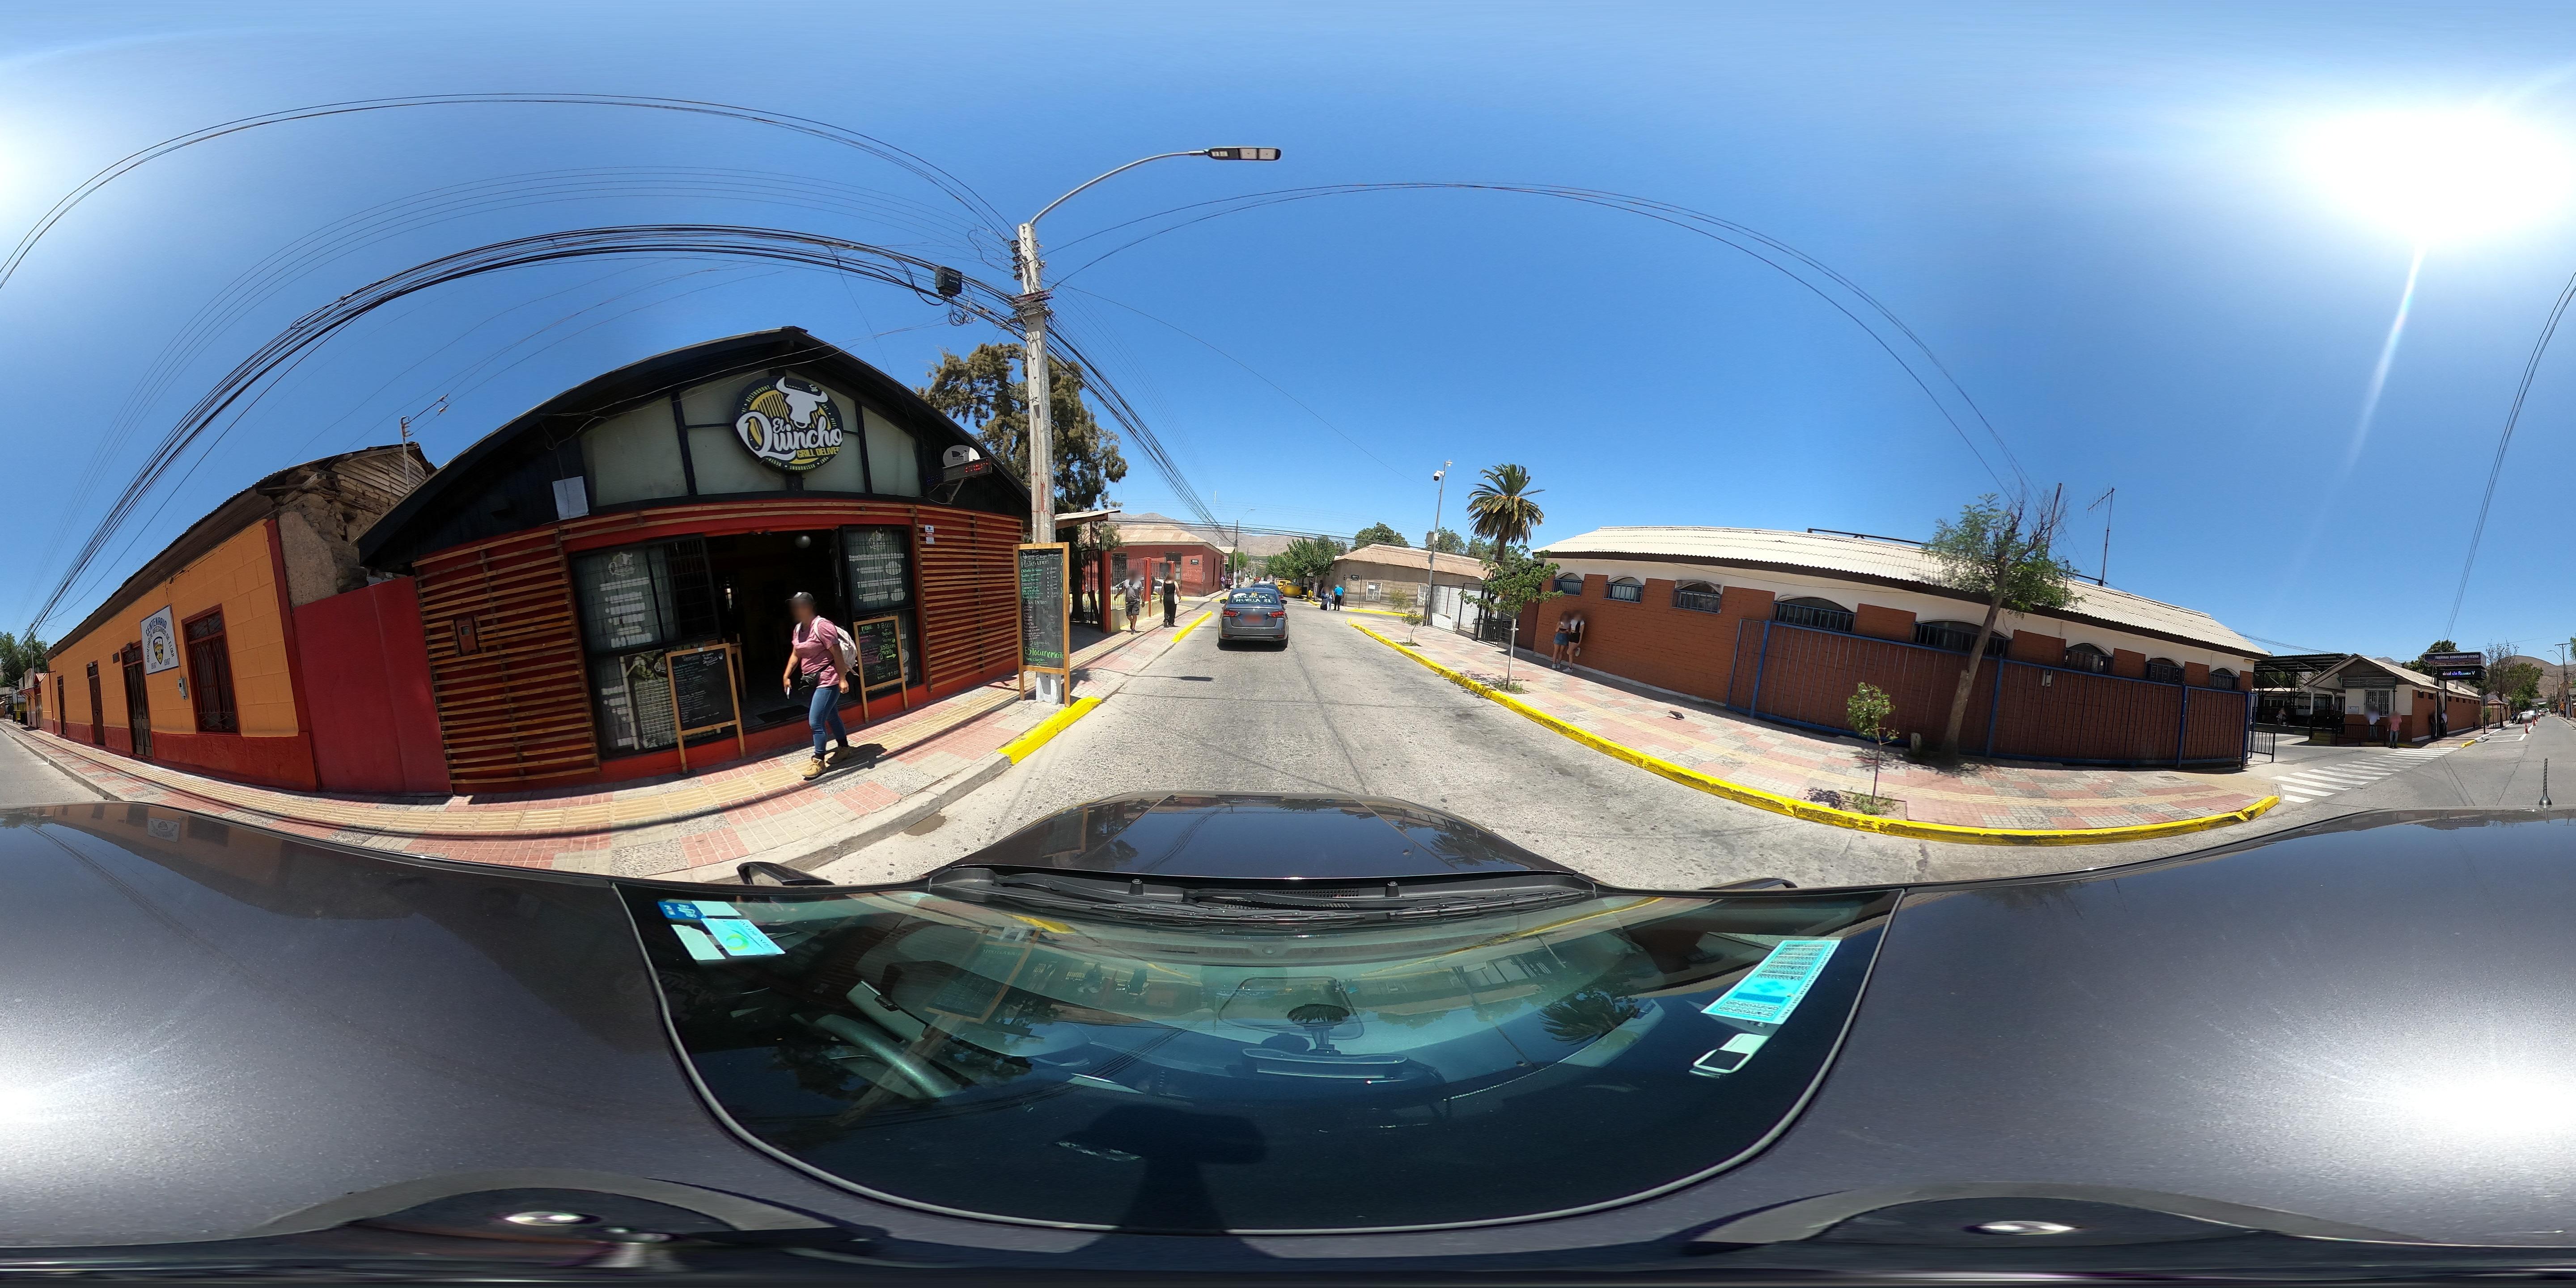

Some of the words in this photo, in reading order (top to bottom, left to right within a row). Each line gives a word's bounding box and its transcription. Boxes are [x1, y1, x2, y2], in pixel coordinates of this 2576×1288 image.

[773, 418, 786, 432] El
[736, 411, 843, 461] Quincho
[797, 448, 816, 458] GRILL
[146, 617, 167, 637] CENTENARIO
